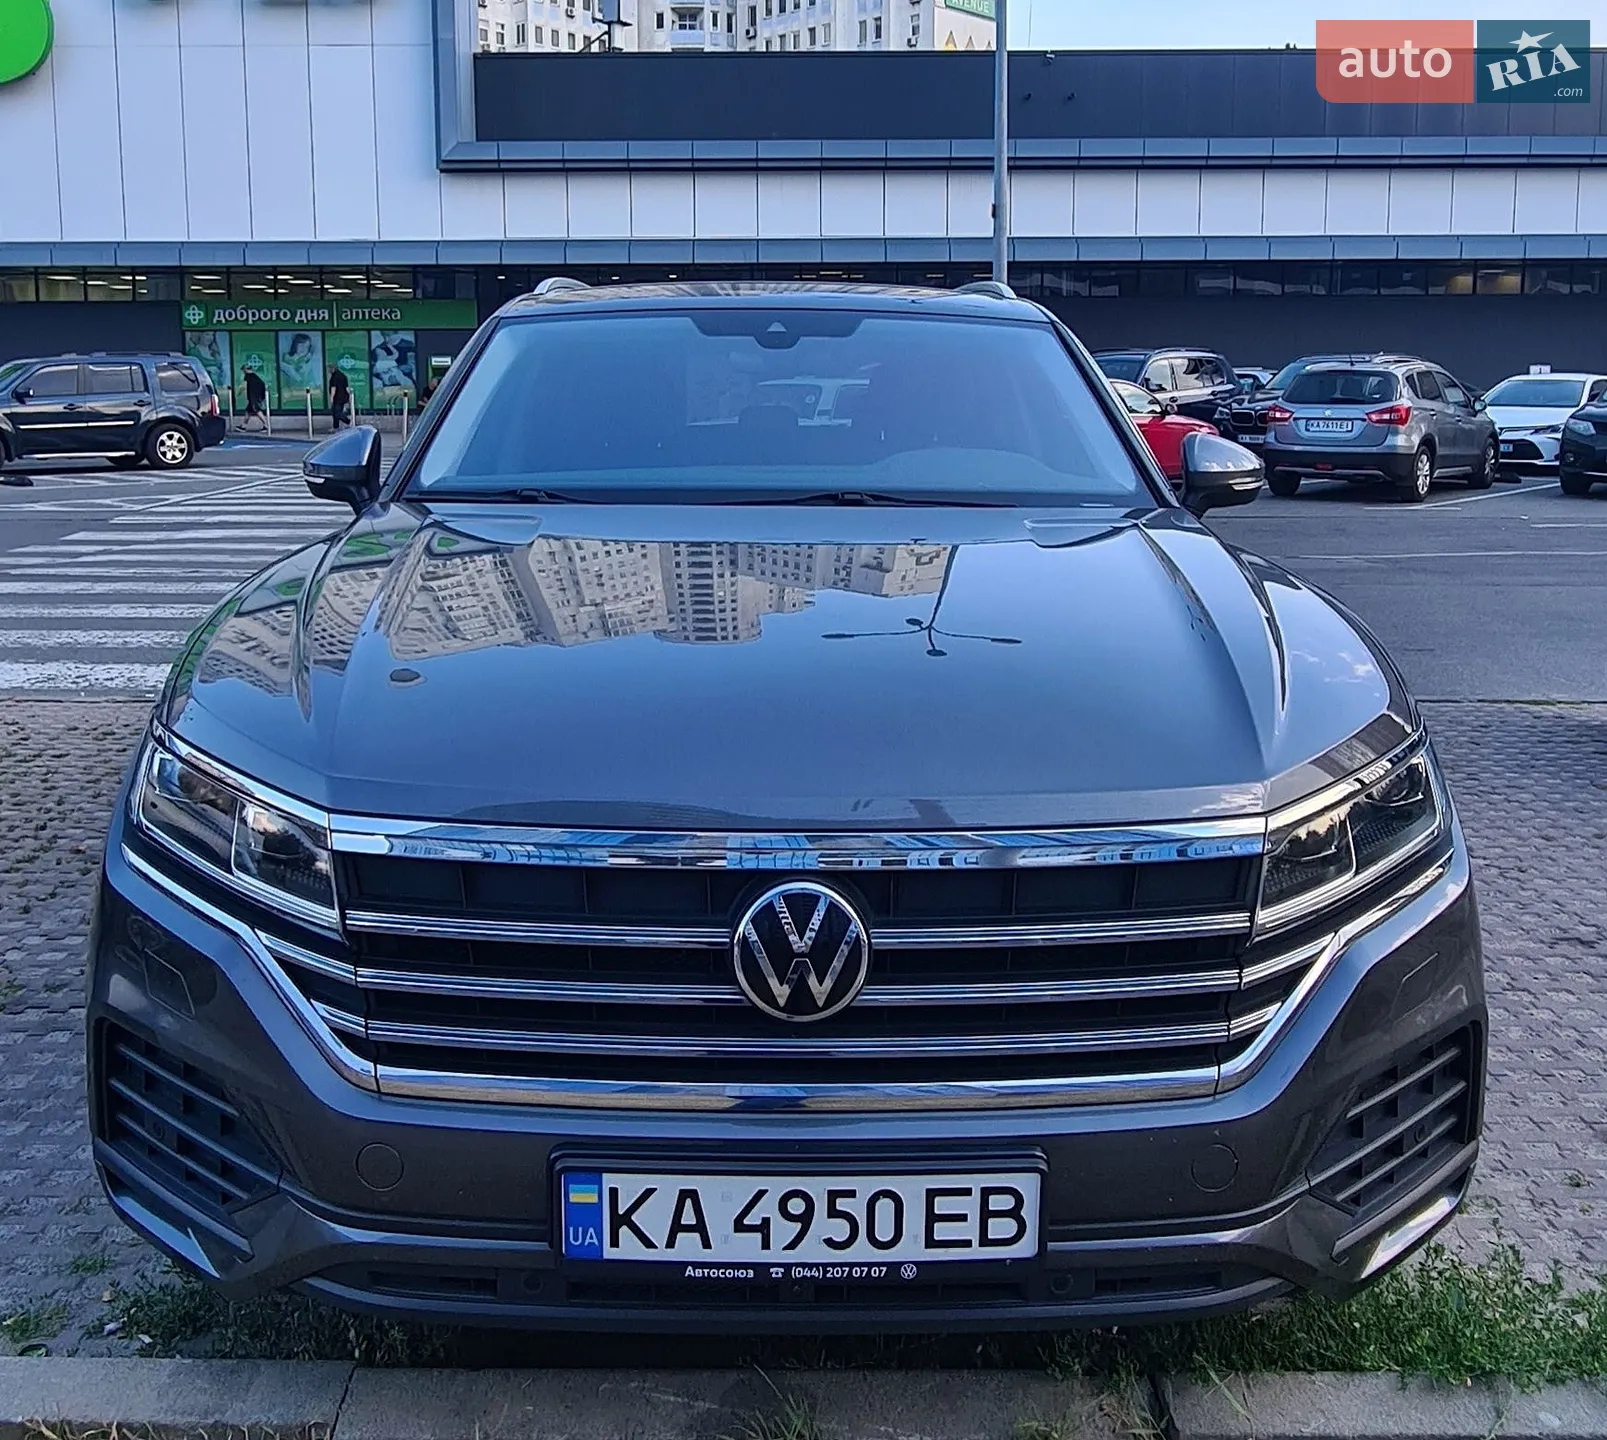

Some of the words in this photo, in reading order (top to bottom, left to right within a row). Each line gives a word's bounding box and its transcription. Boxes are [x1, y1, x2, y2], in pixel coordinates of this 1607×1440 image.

[213, 304, 291, 325] доброго
[294, 308, 329, 324] дня
[341, 306, 401, 321] аптека
[608, 1186, 713, 1250] KA
[733, 1188, 904, 1251] 4950
[924, 1186, 1027, 1249] EB
[569, 1227, 599, 1247] UA
[685, 1266, 754, 1278] Автосоюз
[791, 1266, 823, 1279] (044)
[826, 1267, 849, 1278] 207
[852, 1267, 868, 1278] 07
[871, 1267, 887, 1278] 07
